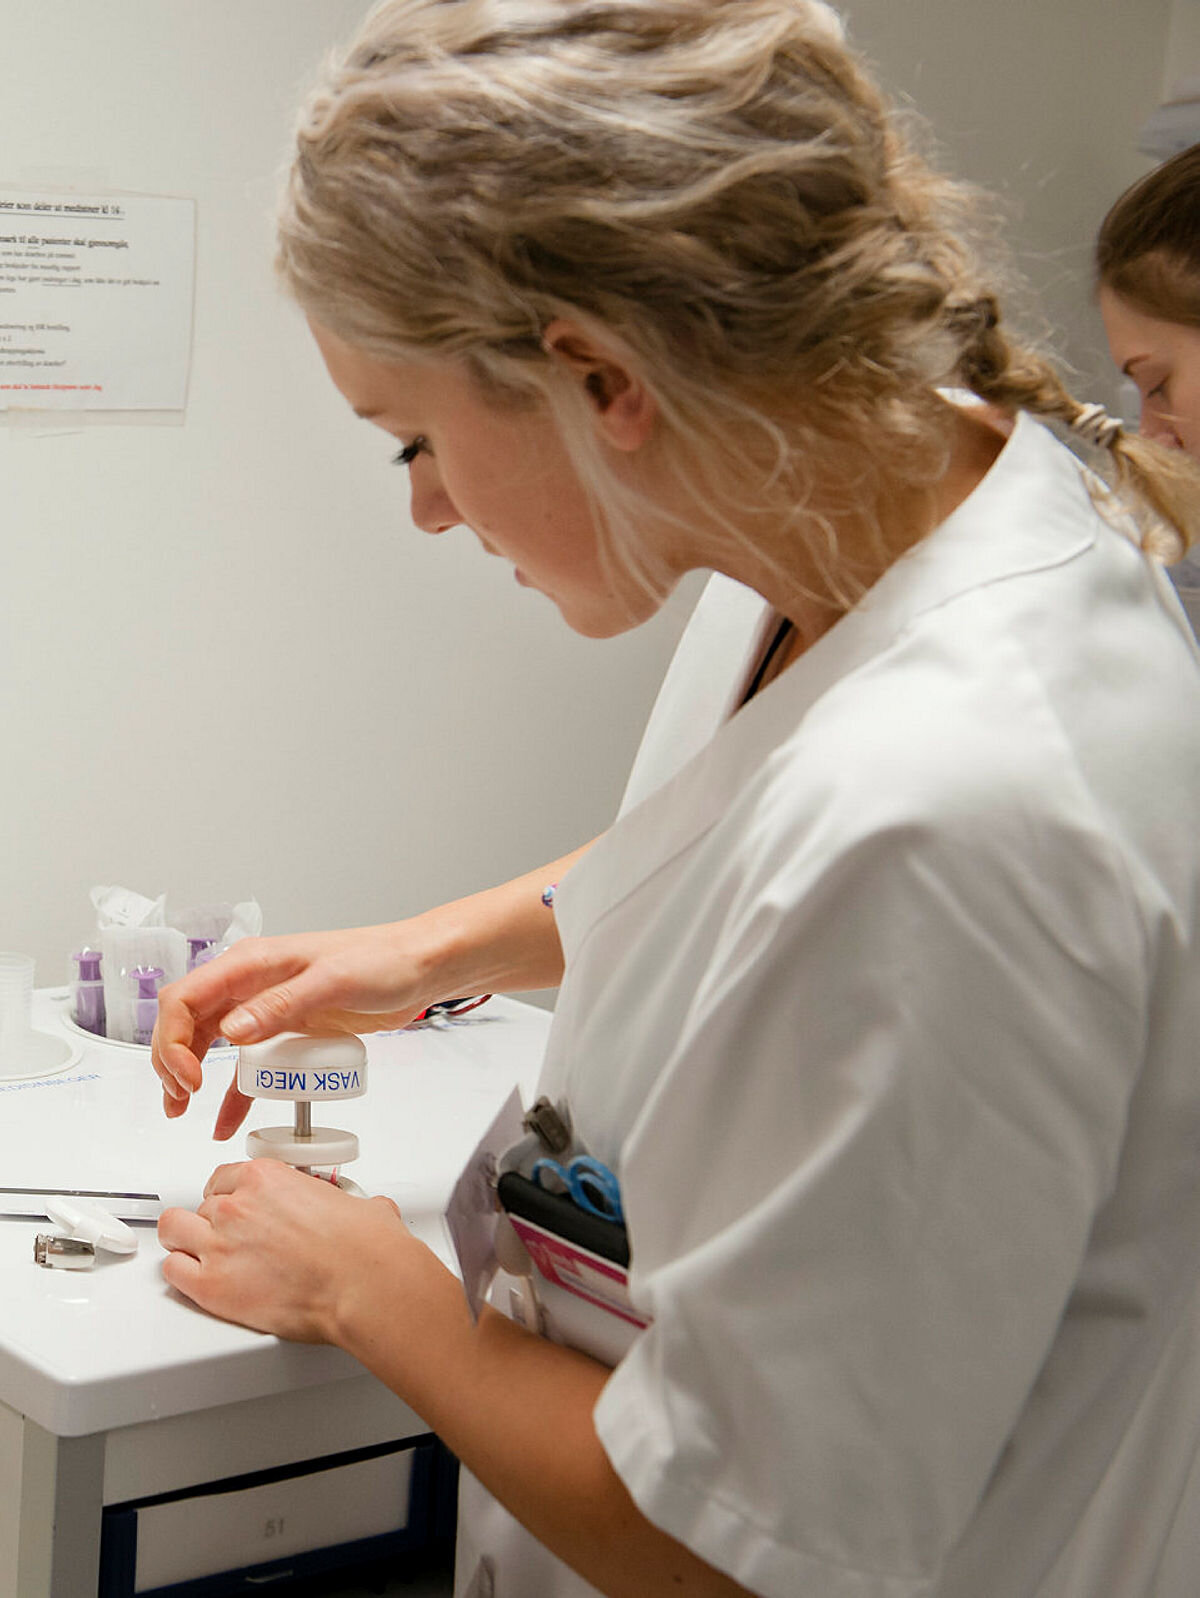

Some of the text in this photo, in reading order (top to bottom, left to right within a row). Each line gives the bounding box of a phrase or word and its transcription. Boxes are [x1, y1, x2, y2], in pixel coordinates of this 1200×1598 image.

[256, 1069, 360, 1091] VASK MEG!
[264, 1518, 284, 1539] 51
